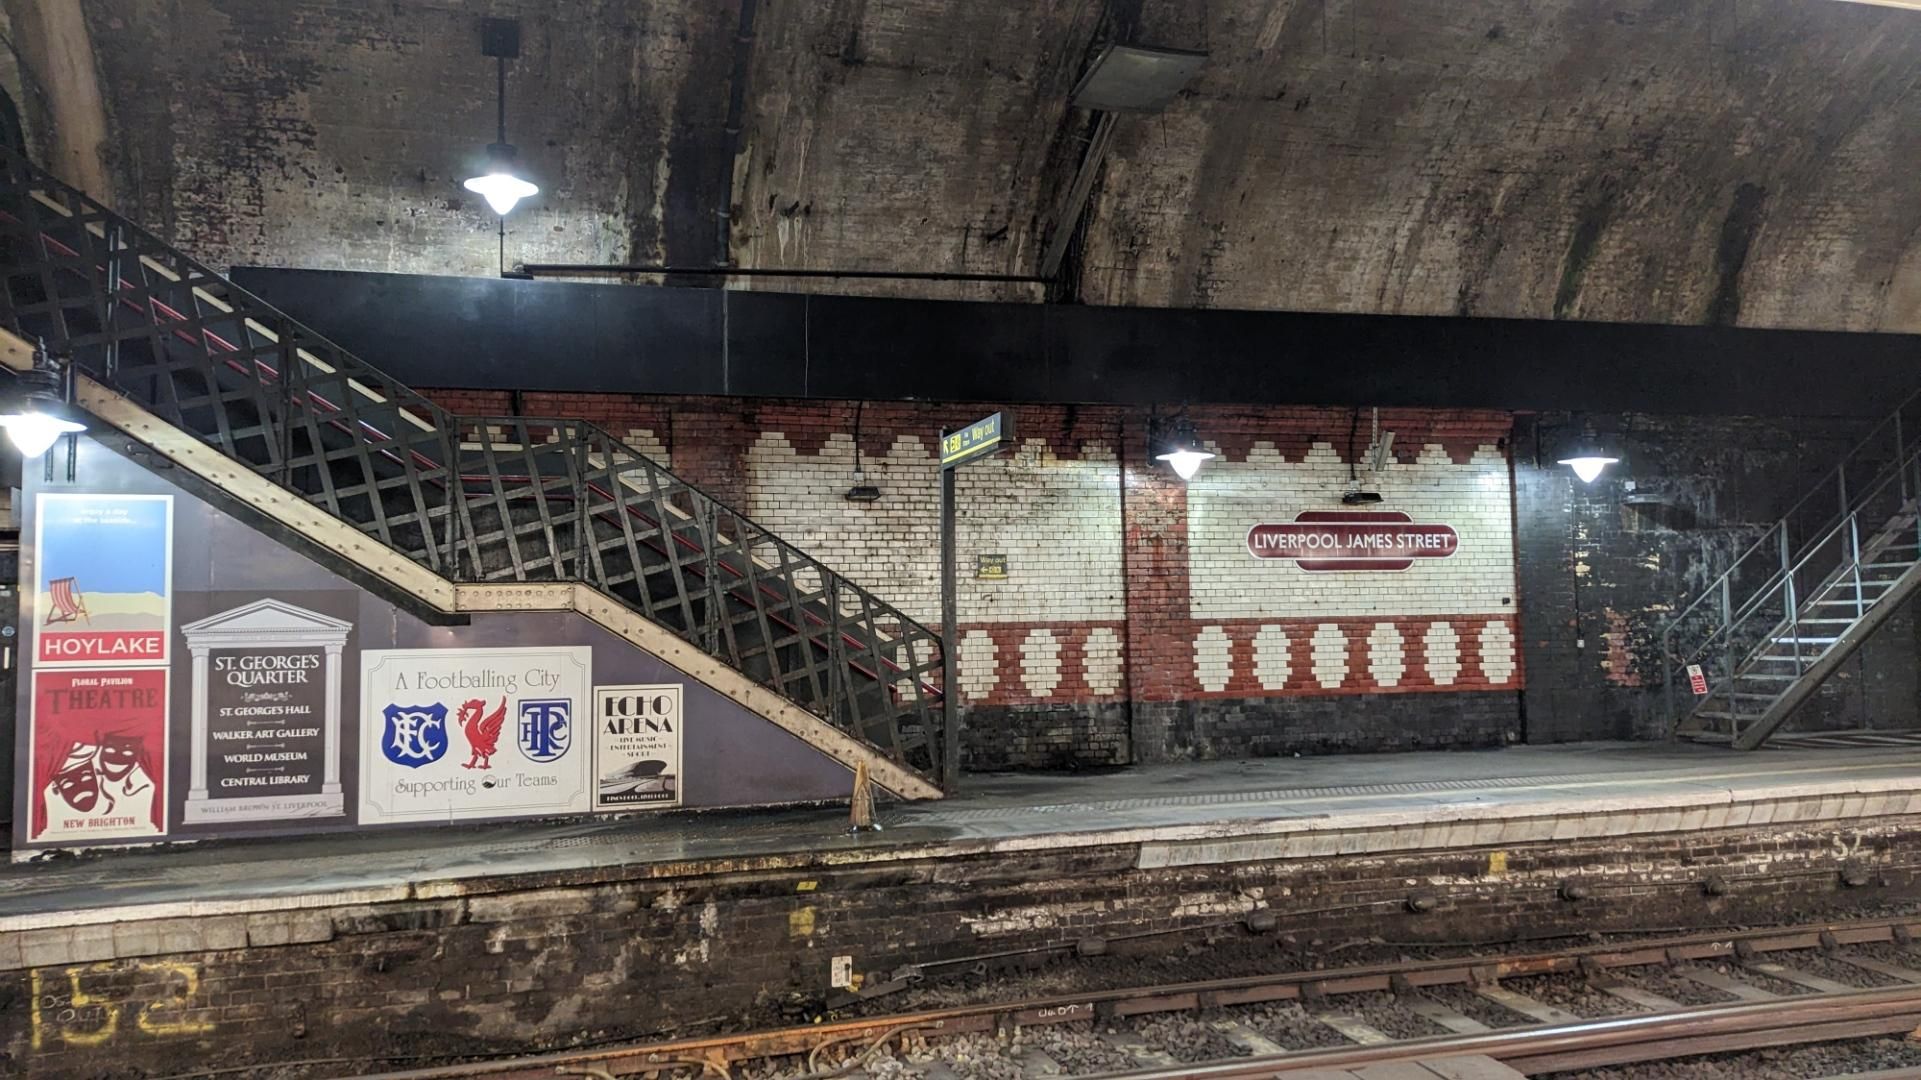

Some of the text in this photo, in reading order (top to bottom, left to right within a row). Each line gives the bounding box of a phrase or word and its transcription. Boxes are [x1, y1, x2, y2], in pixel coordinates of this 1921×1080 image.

[1254, 534, 1452, 549] LIVERPOOL JAMES STREET
[45, 637, 160, 655] HOYLAKE
[215, 654, 320, 671] ST. GEORGE'S
[227, 670, 309, 687] QUARTER
[395, 669, 561, 694] A Footballing City
[46, 688, 158, 714] THEATRE
[285, 705, 311, 714] HALL
[606, 695, 672, 716] ECHO
[212, 728, 320, 740] WALKER ART GALLERY
[603, 717, 673, 734] ARENA
[224, 752, 307, 763] WORLD MUSEUM
[221, 774, 311, 787] CENTRAL LIBRARY
[395, 773, 558, 797] Supporting Our Teams
[284, 801, 328, 810] LIVERPOOL
[63, 817, 135, 829] NEW BRIGHTON
